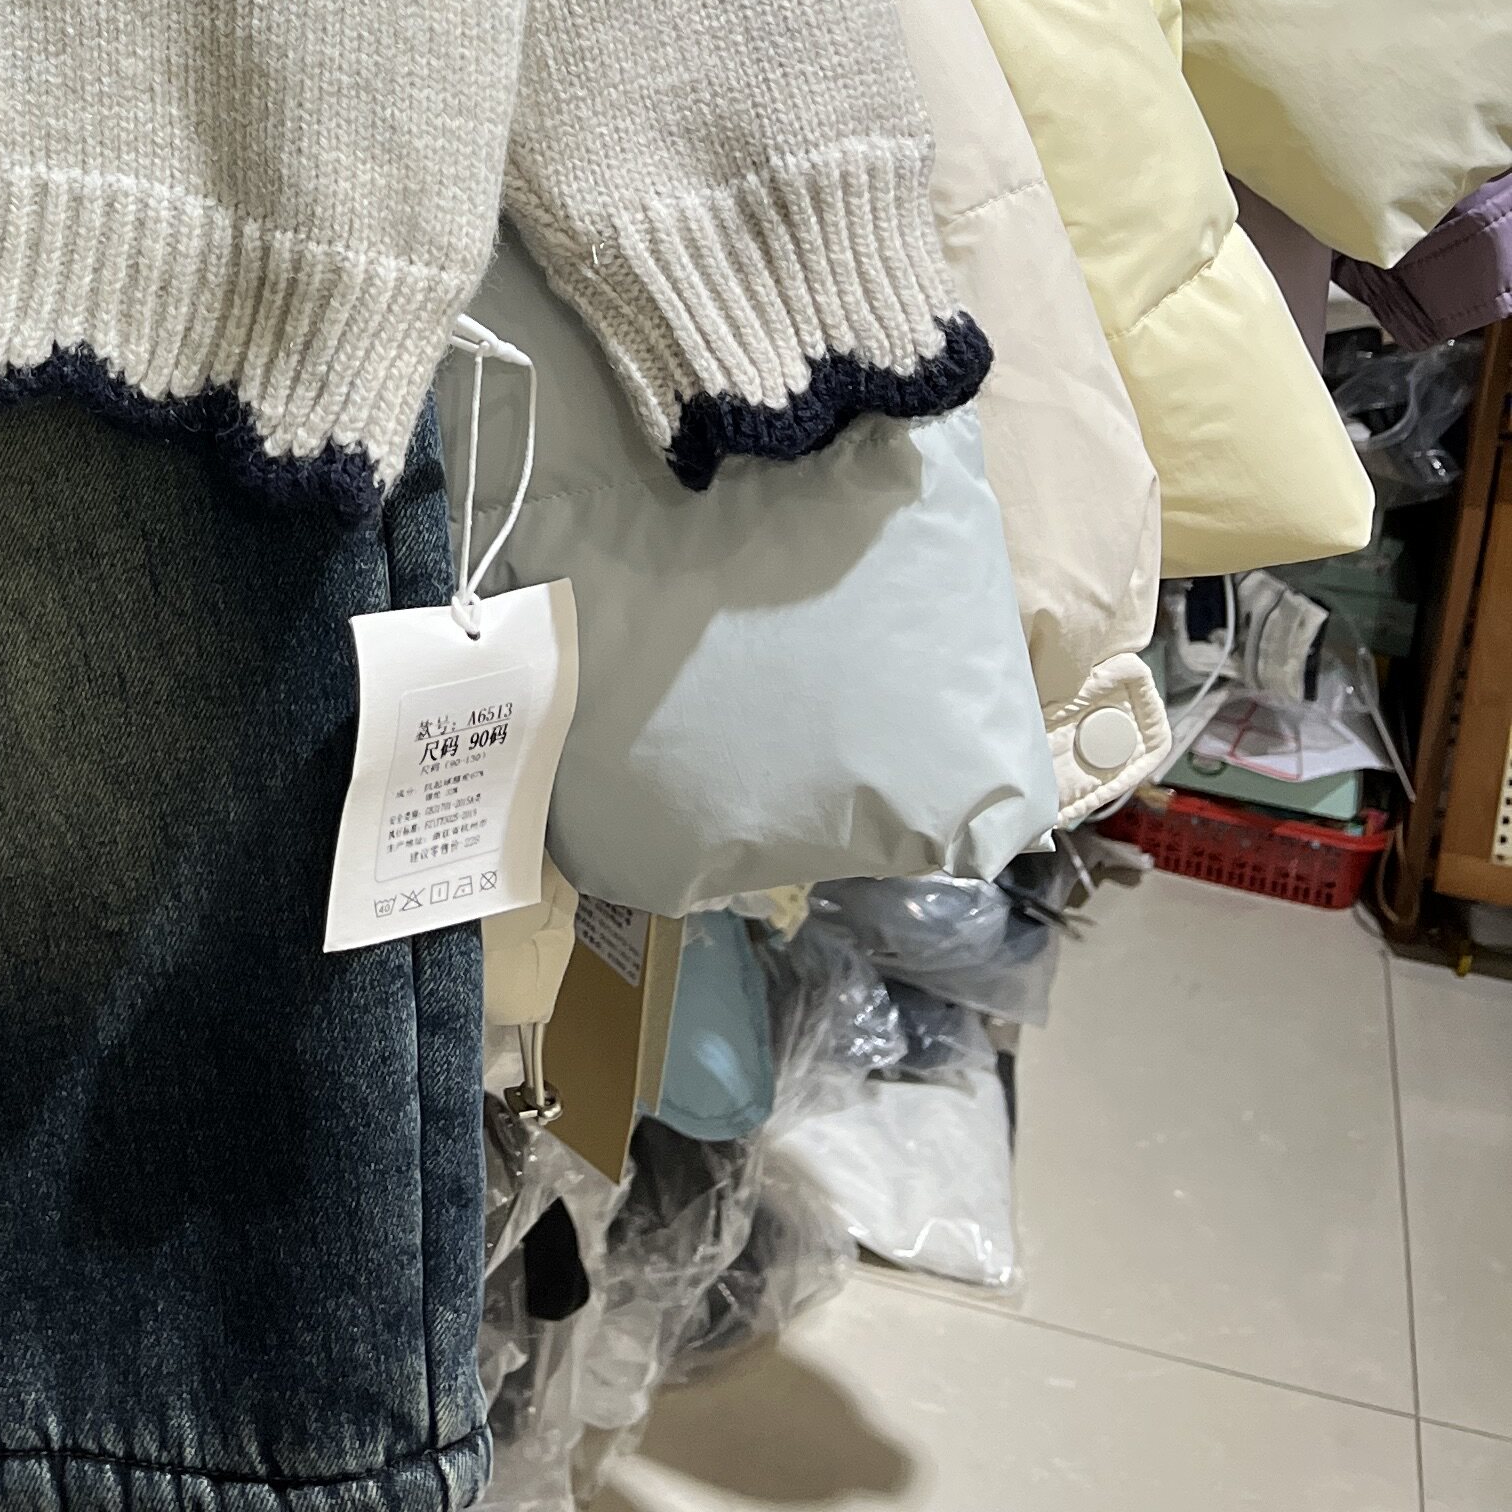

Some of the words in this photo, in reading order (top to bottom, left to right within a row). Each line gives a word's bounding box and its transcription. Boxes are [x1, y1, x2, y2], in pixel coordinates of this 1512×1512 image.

[467, 702, 513, 727] A6513
[418, 734, 460, 766] 尺码
[468, 722, 508, 751] 90码
